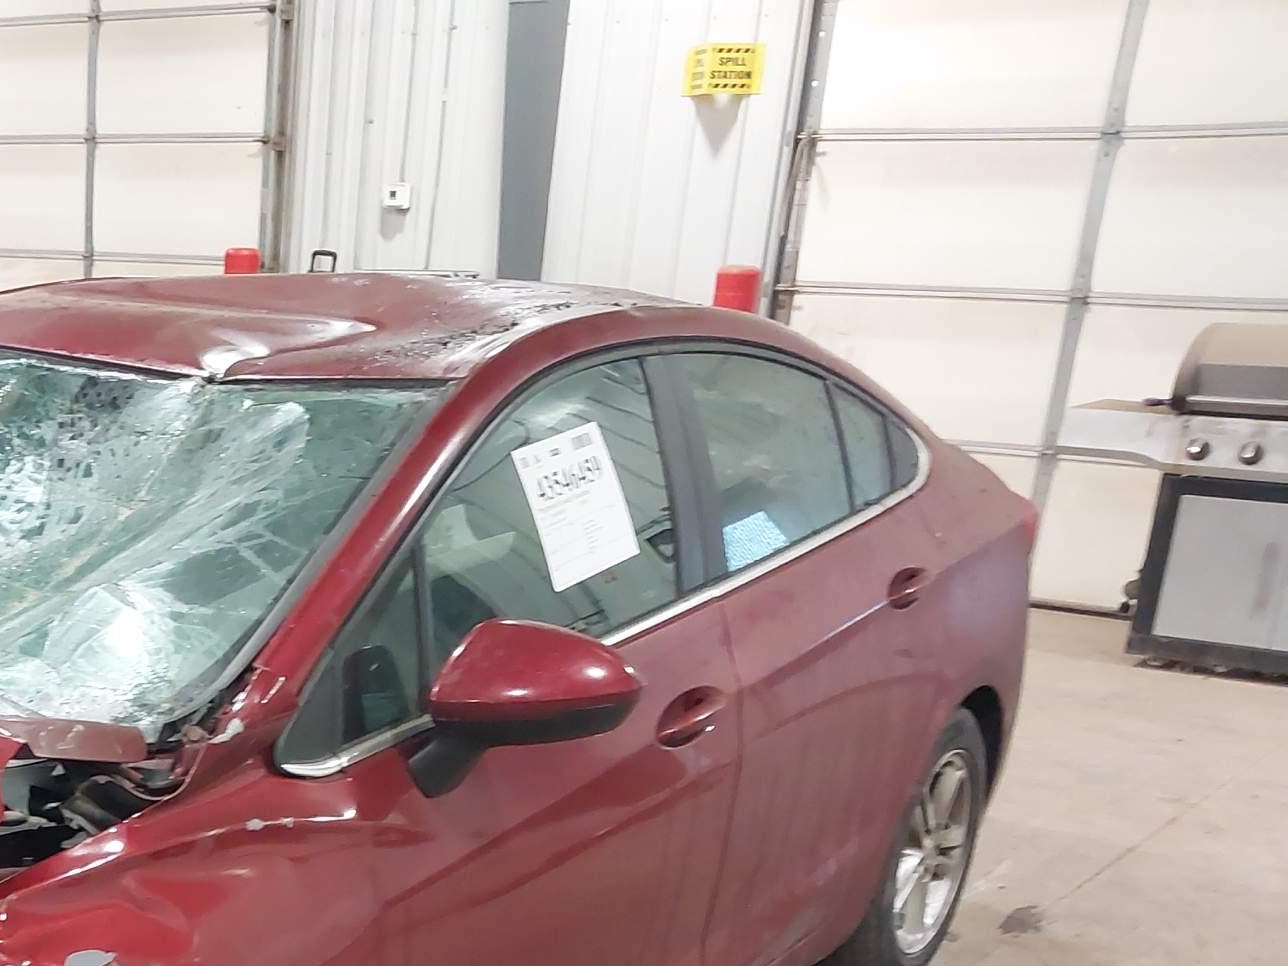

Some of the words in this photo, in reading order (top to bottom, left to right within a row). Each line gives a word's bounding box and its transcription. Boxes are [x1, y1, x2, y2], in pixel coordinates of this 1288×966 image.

[718, 56, 747, 66] SPILL
[709, 70, 753, 80] STATION
[536, 455, 601, 501] 43546459
